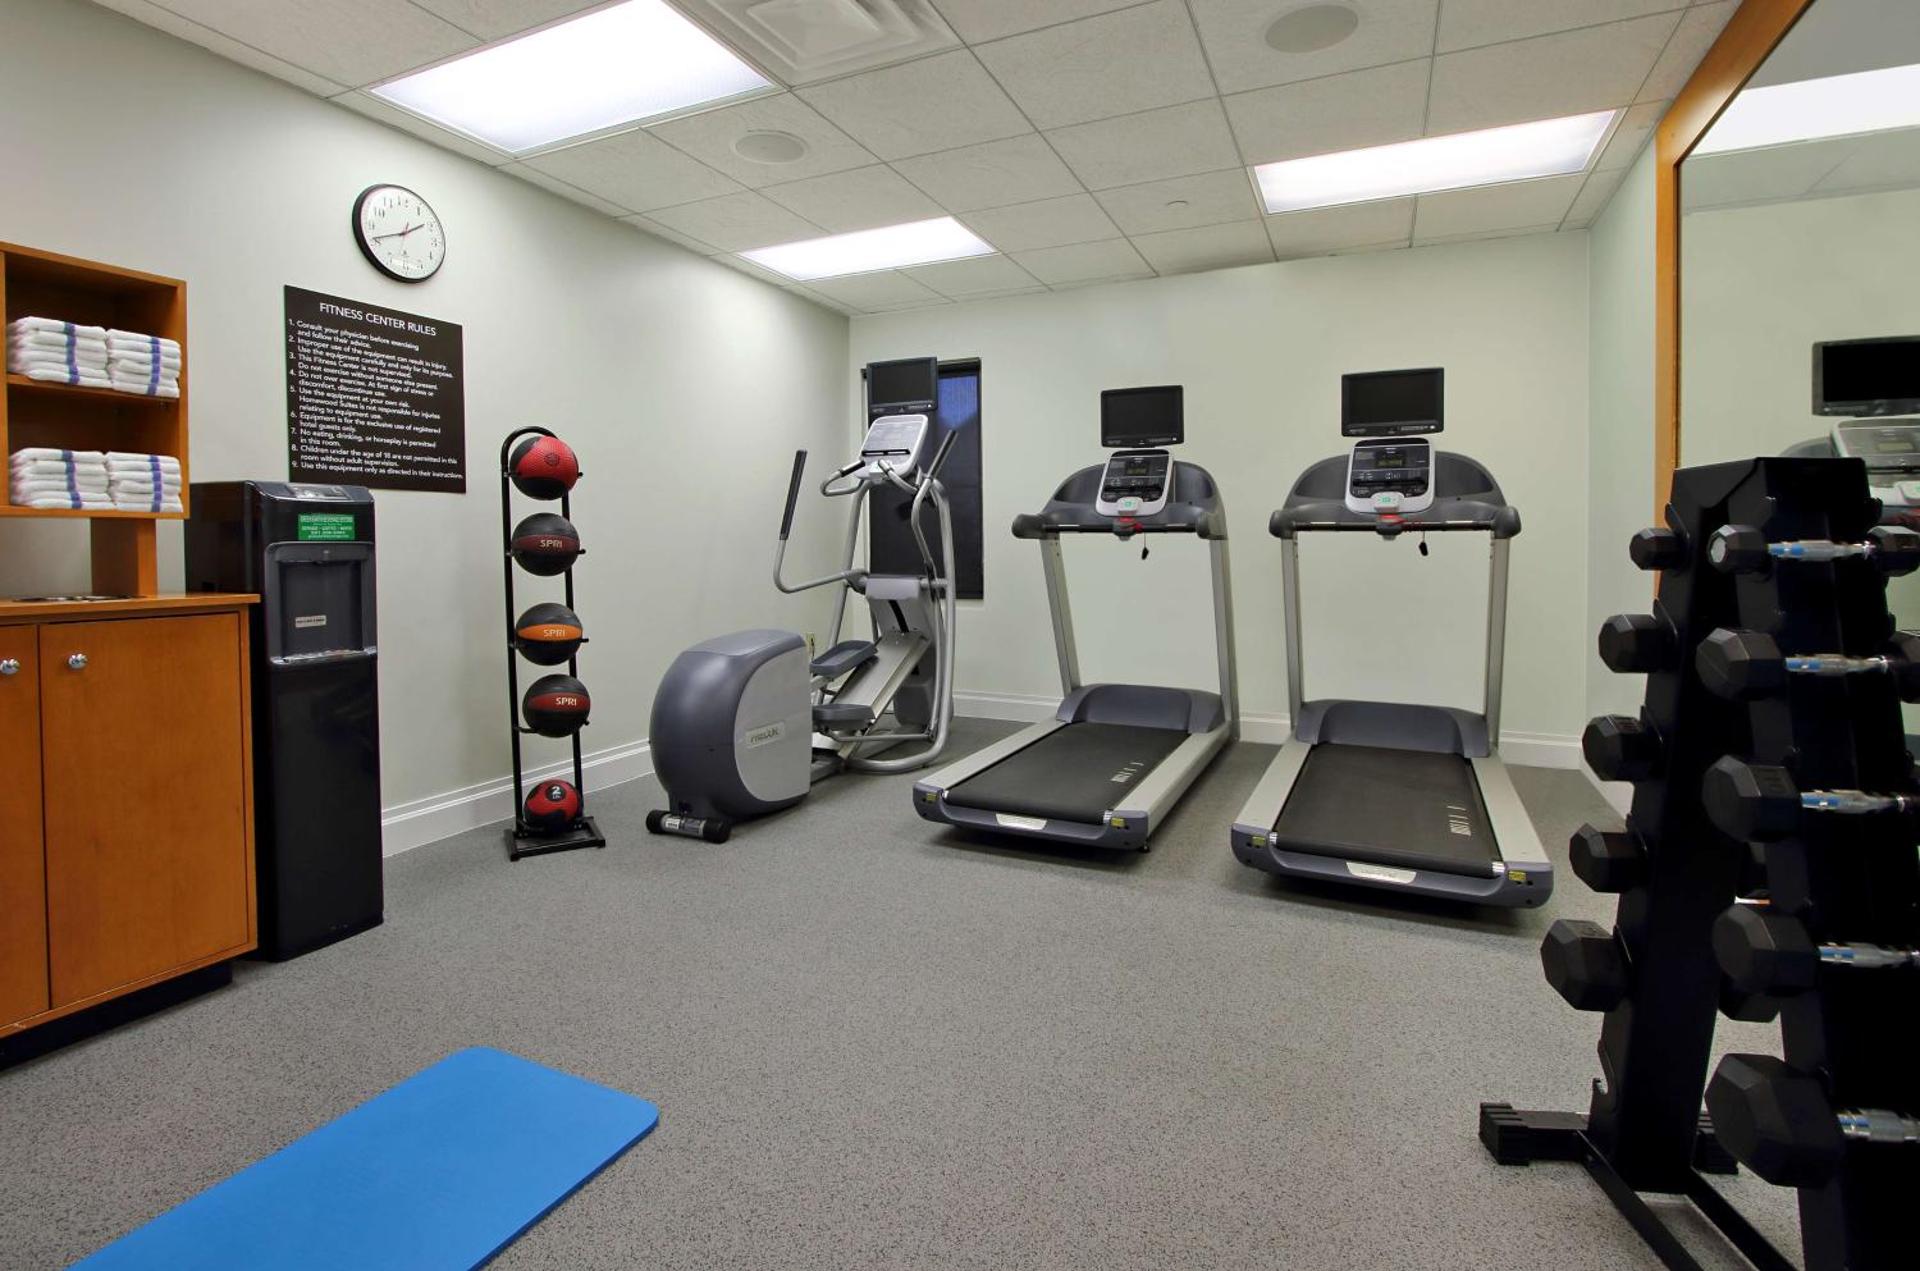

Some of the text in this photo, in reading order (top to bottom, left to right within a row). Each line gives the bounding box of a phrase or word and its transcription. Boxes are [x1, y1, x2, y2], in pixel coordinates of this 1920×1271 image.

[320, 302, 436, 336] FITNESS CENTER RULES
[296, 320, 323, 331] Consult
[370, 335, 389, 344] before
[312, 331, 332, 341] follow
[334, 335, 348, 344] their
[298, 337, 329, 349] Improper
[364, 350, 396, 360] equipment
[298, 345, 311, 353] Use
[312, 347, 324, 355] the
[325, 351, 360, 362] equipment
[361, 358, 386, 368] carefully
[400, 364, 412, 372] only
[298, 353, 312, 361] This
[313, 356, 337, 366] Fitness
[338, 360, 359, 369] Center
[324, 367, 349, 376] exercise
[351, 371, 374, 380] without
[376, 376, 402, 384] someone
[338, 384, 373, 395] discontinue
[390, 385, 402, 393] sign
[326, 392, 361, 401] equipment
[299, 395, 338, 406] Homewood
[377, 406, 411, 415] responsible
[299, 404, 325, 414] relating
[335, 409, 369, 418] equipment
[300, 411, 336, 421] Equipment
[374, 436, 402, 446] horseplay
[300, 445, 329, 453] Children
[329, 464, 363, 472] equipment
[540, 540, 562, 548] SPRI
[544, 629, 566, 637] SPRI
[555, 697, 577, 706] SPRI
[552, 786, 561, 794] 2
